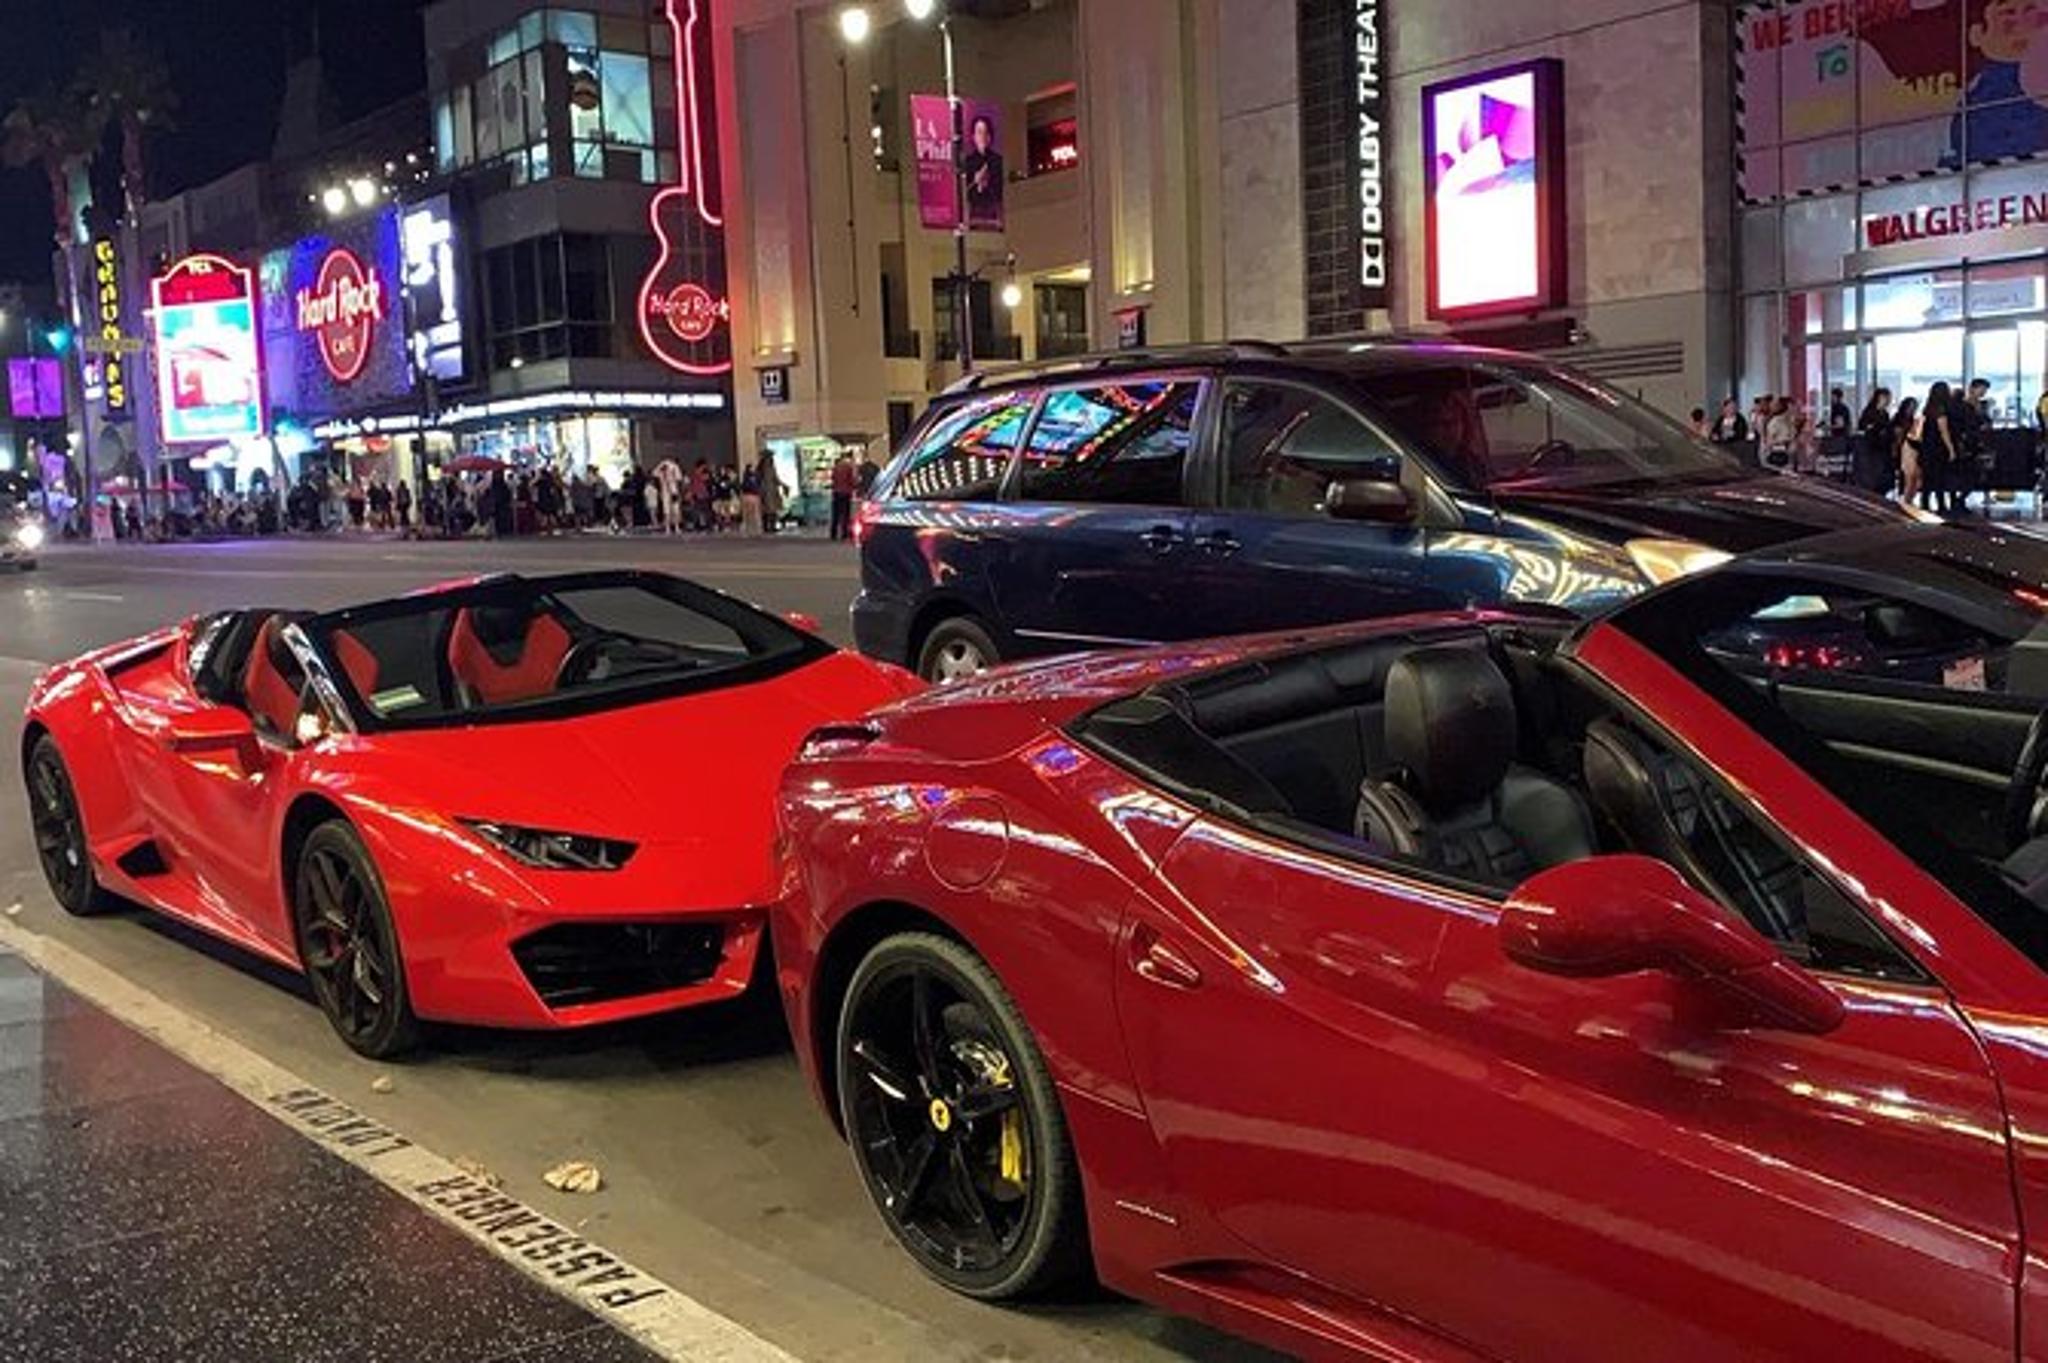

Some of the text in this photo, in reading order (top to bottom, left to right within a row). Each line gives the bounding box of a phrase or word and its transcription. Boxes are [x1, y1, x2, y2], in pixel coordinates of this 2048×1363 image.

[1753, 15, 1793, 51] WE
[1816, 44, 1849, 82] TO
[916, 118, 936, 139] LA
[916, 139, 952, 160] Phil
[1359, 112, 1382, 233] DOLBY
[297, 267, 381, 331] Hard Rock
[650, 293, 730, 322] Hard Rock
[416, 1176, 667, 1308] PASSENGER
